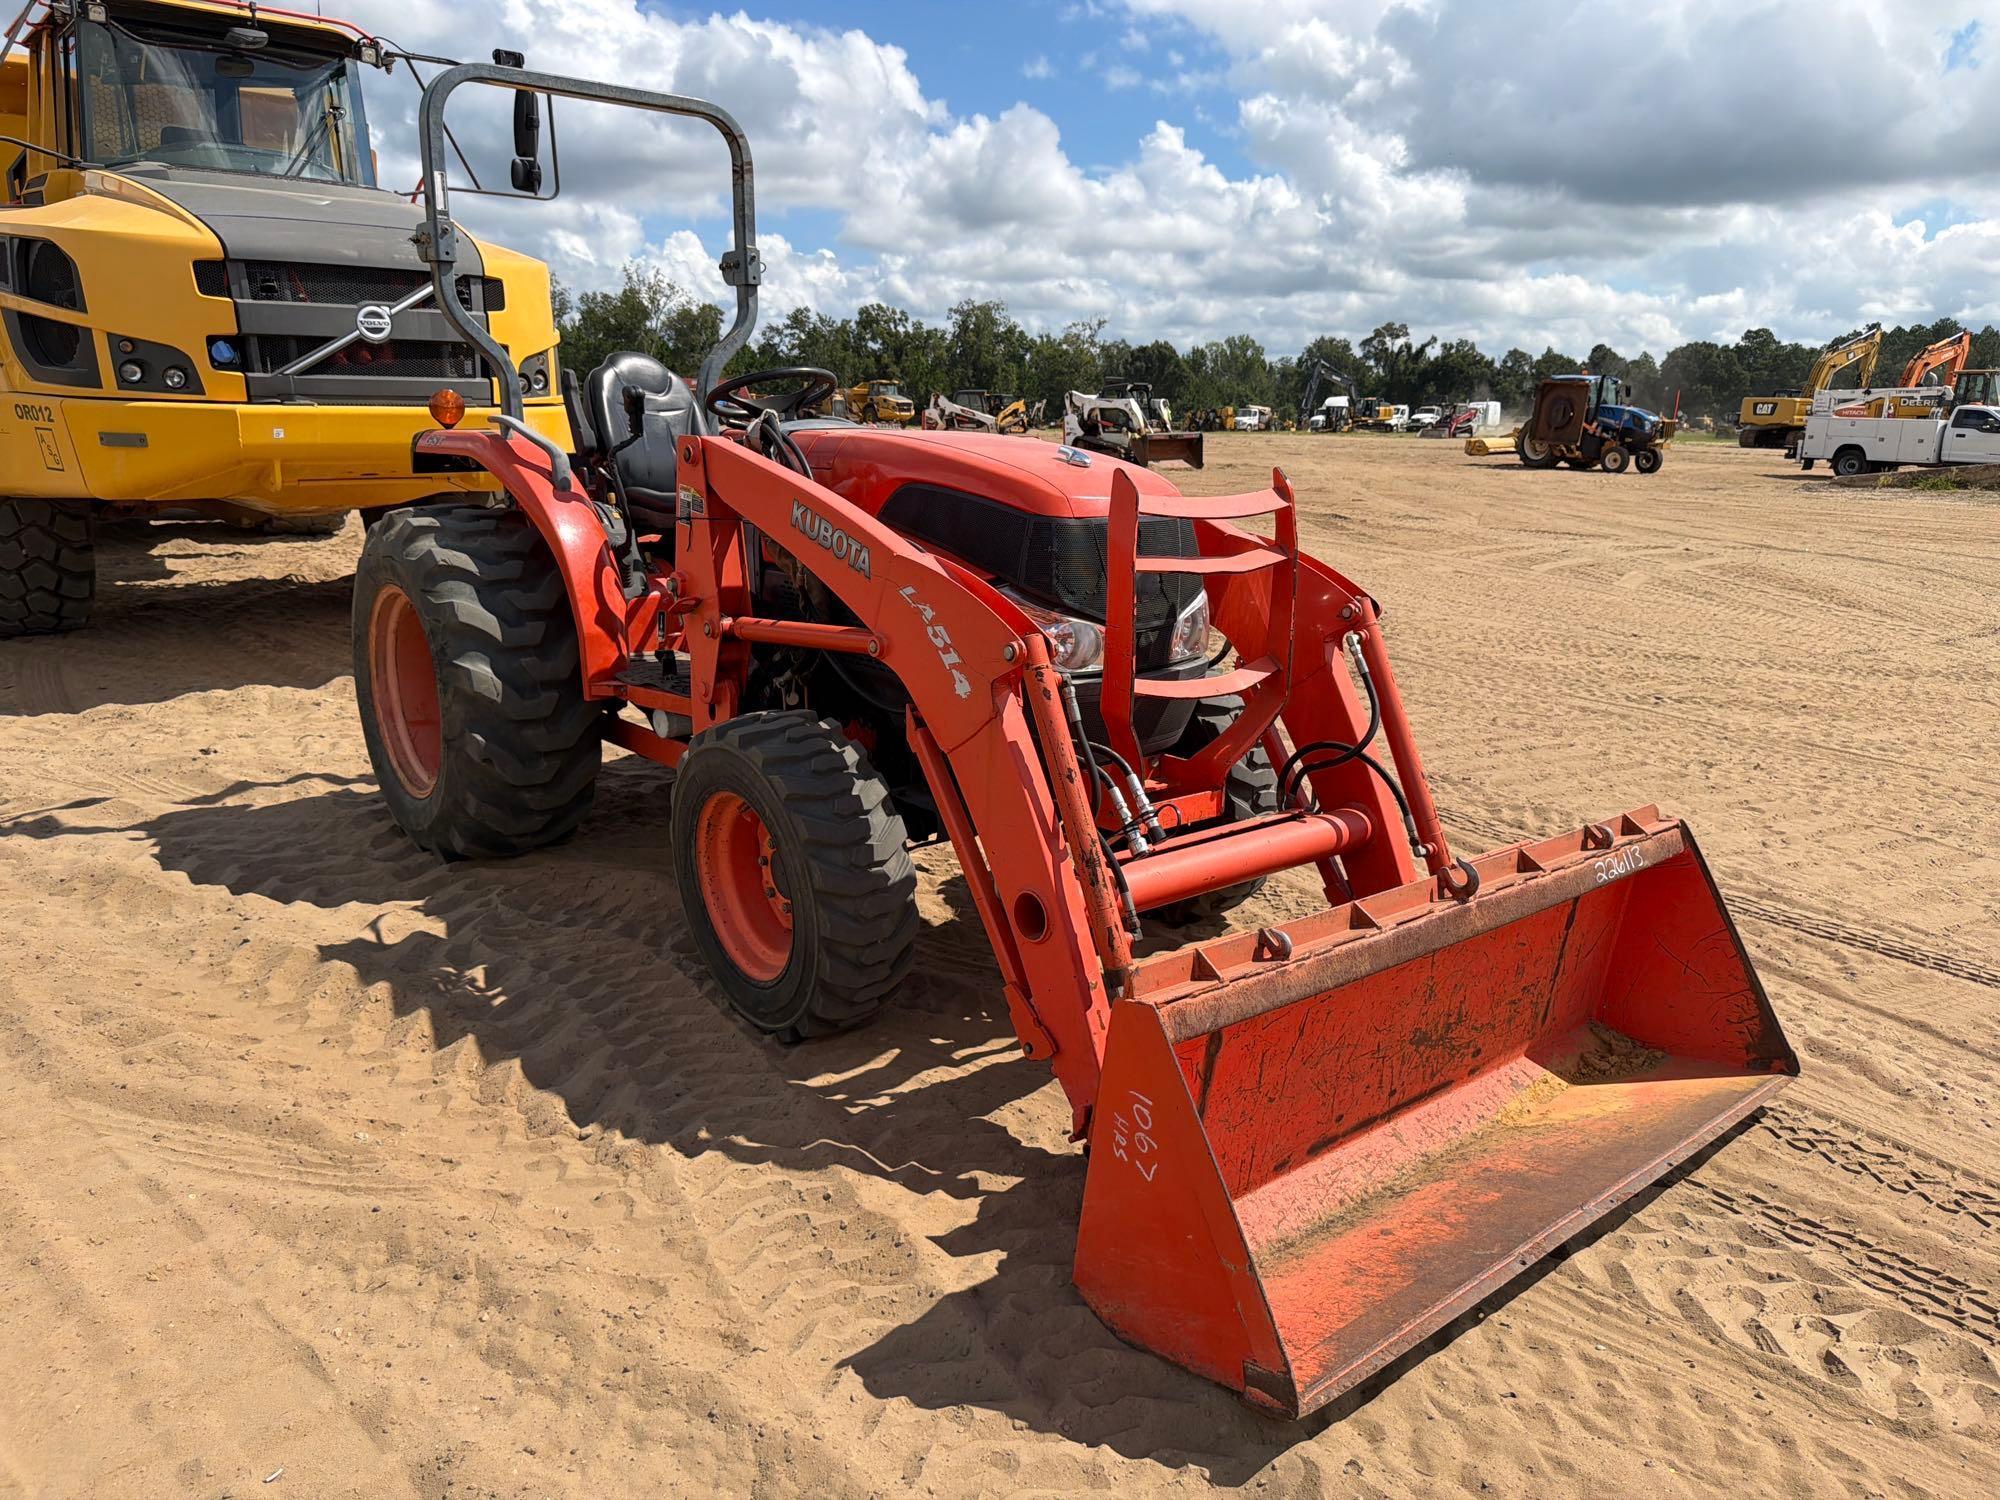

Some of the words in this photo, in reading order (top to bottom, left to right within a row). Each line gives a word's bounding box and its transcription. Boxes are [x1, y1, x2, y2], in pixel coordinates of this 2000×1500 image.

[1756, 403, 1774, 415] CAT
[791, 498, 872, 581] KUBOTA
[899, 585, 972, 700] LA514
[1594, 845, 1644, 883] 226113
[1128, 1090, 1158, 1182] 1067
